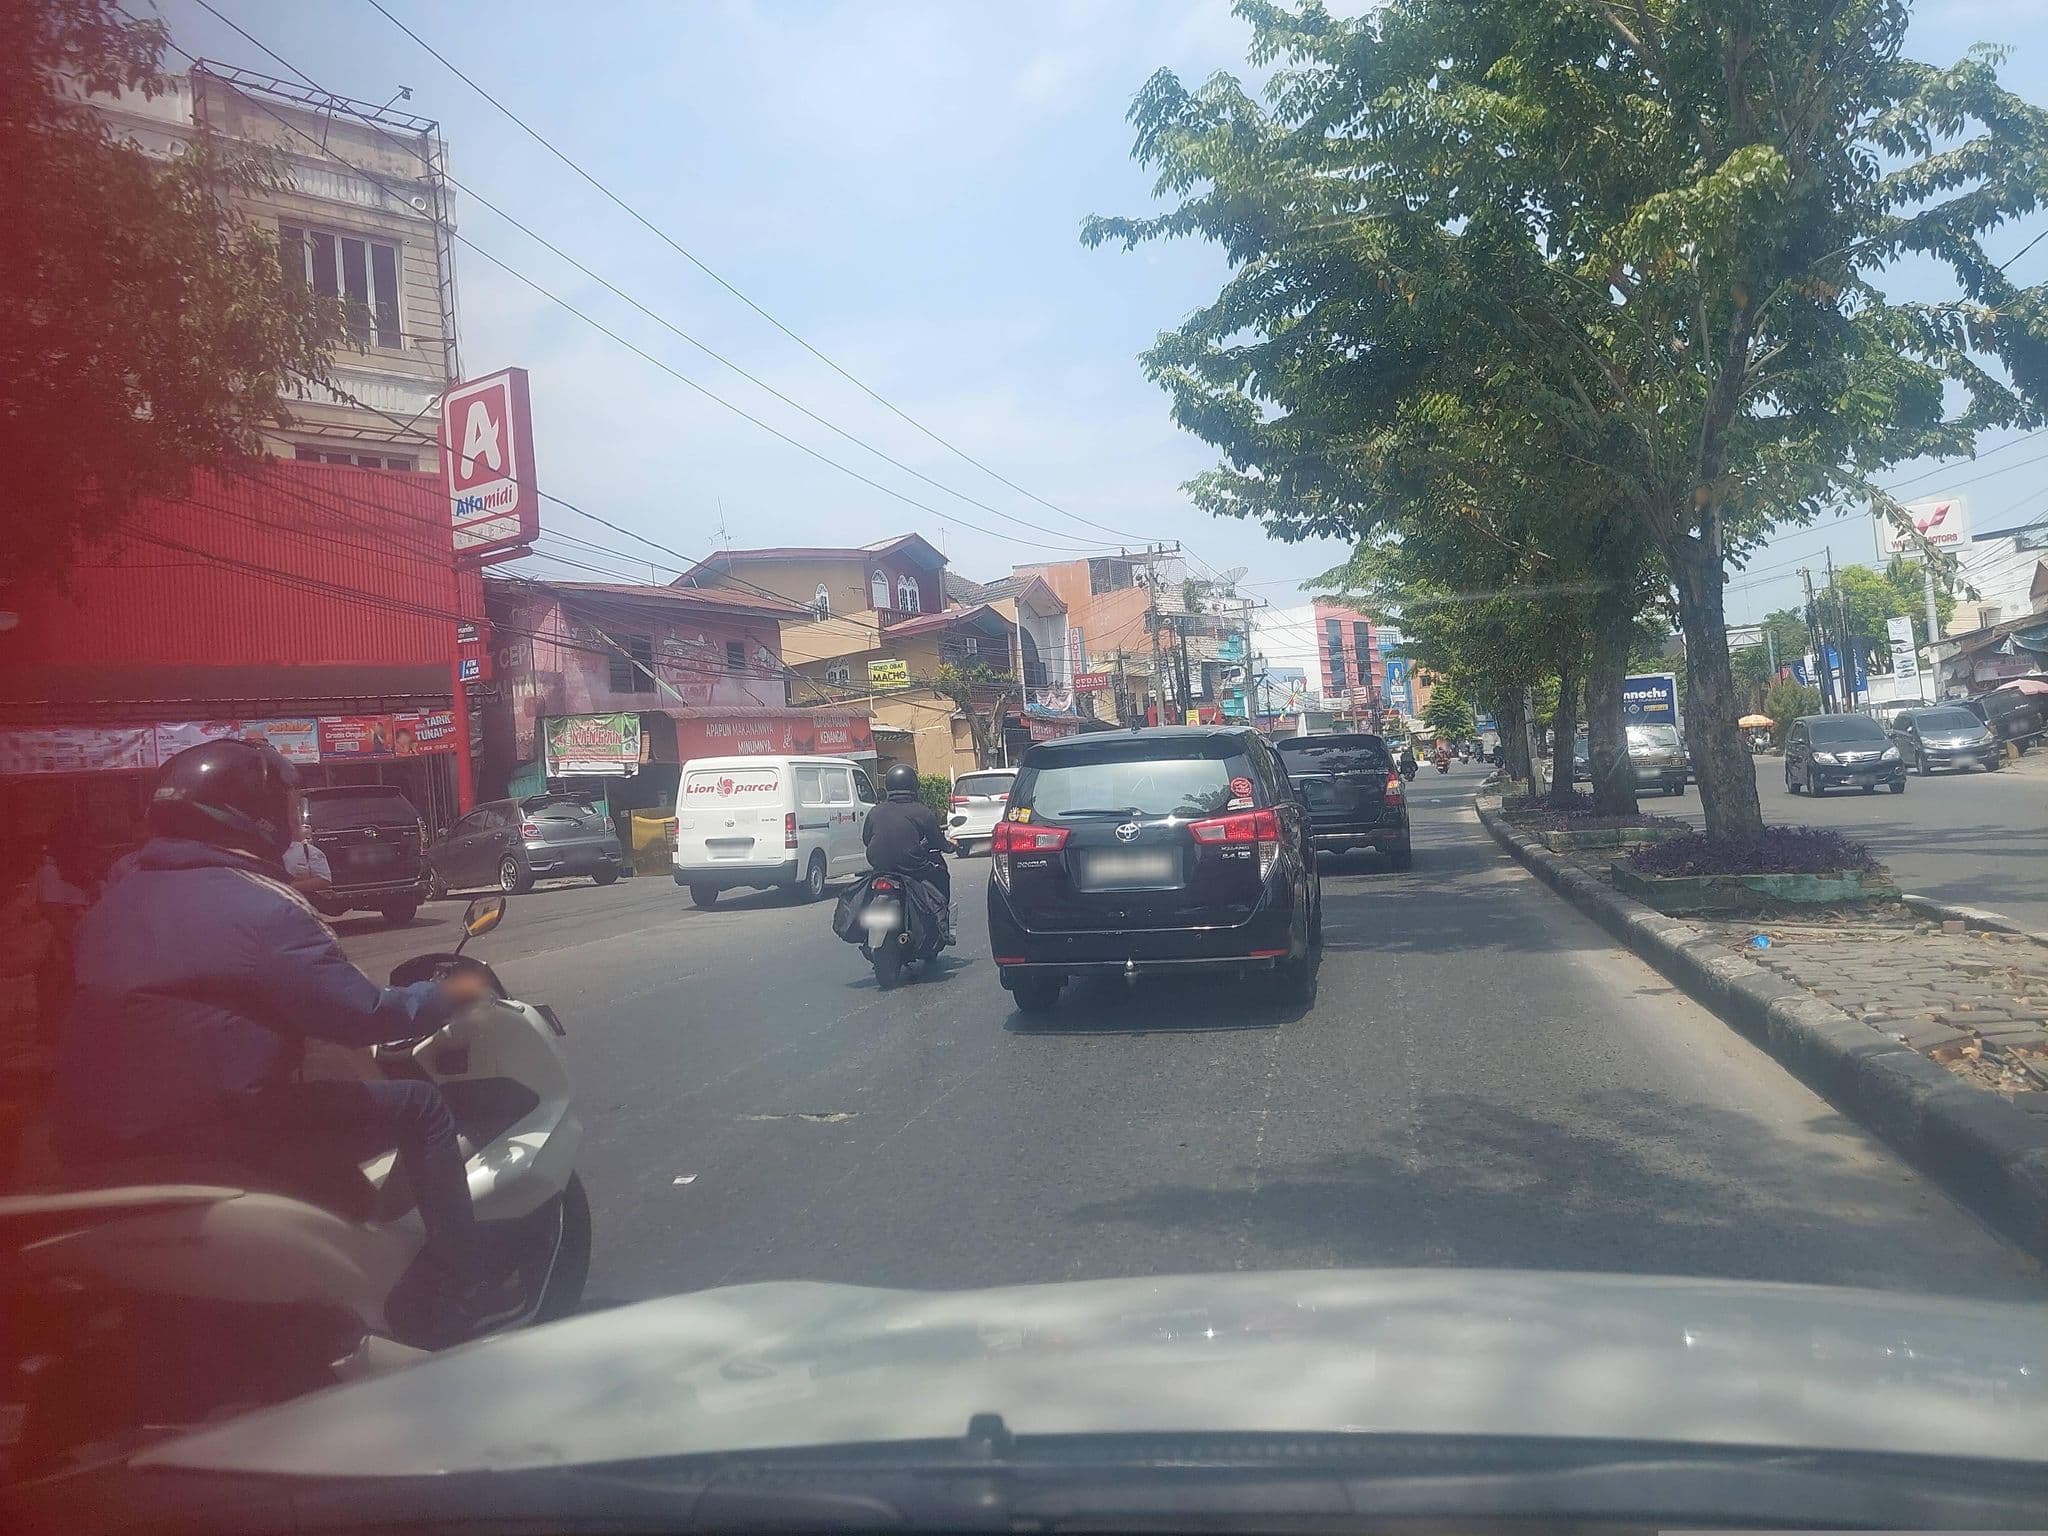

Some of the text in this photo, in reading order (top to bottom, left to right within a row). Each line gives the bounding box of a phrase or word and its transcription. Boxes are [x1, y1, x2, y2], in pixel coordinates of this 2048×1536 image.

[456, 485, 513, 516] Alfamidi
[1925, 533, 1958, 545] MOTORS
[872, 670, 906, 682] MACHO
[425, 714, 452, 727] TARIK
[414, 727, 443, 741] TUNAI
[705, 722, 732, 737] APAPUN
[819, 728, 848, 744] KENANGAN
[686, 781, 779, 794] Lion parcel
